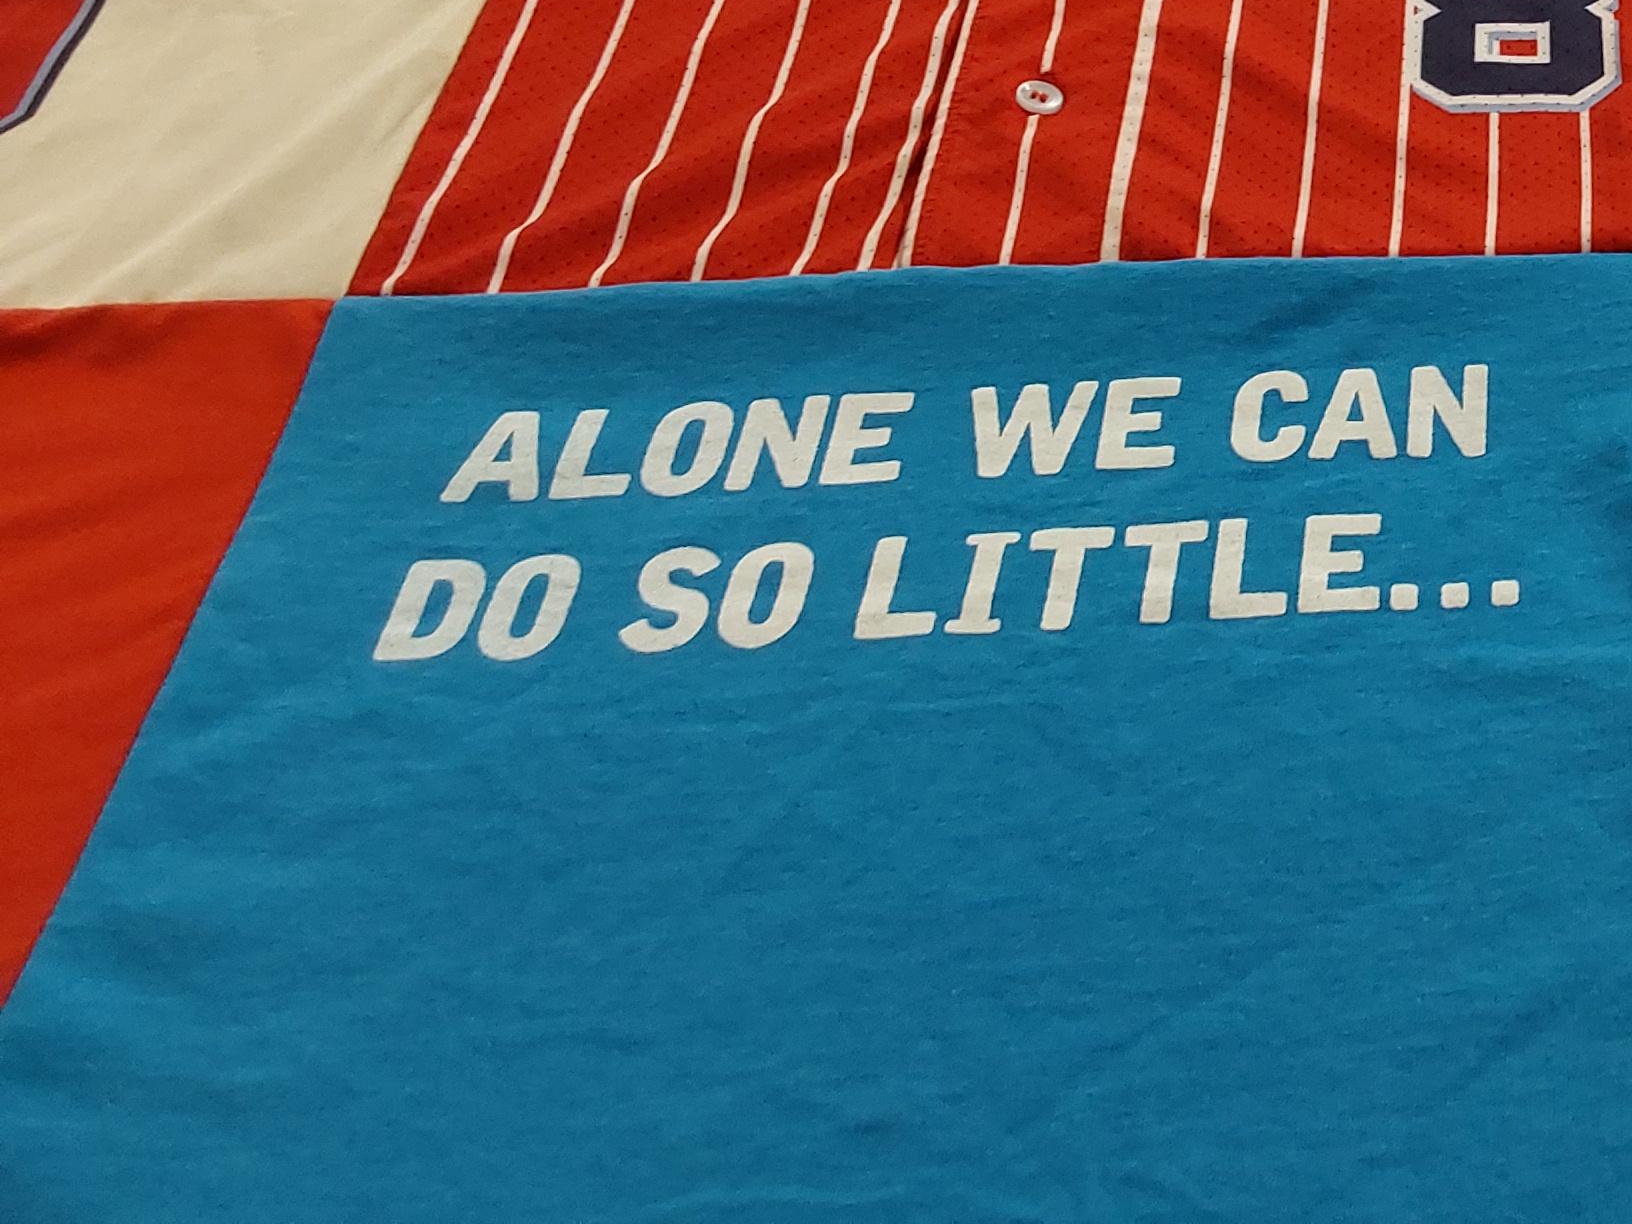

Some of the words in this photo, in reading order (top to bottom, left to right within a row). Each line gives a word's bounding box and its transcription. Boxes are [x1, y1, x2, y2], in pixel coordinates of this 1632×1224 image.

[439, 390, 915, 504] ALONE
[969, 375, 1183, 479] WE
[1228, 363, 1490, 462] CAN
[371, 552, 581, 663] DO
[618, 539, 815, 652] SO
[852, 511, 1522, 640] LITTLE...
